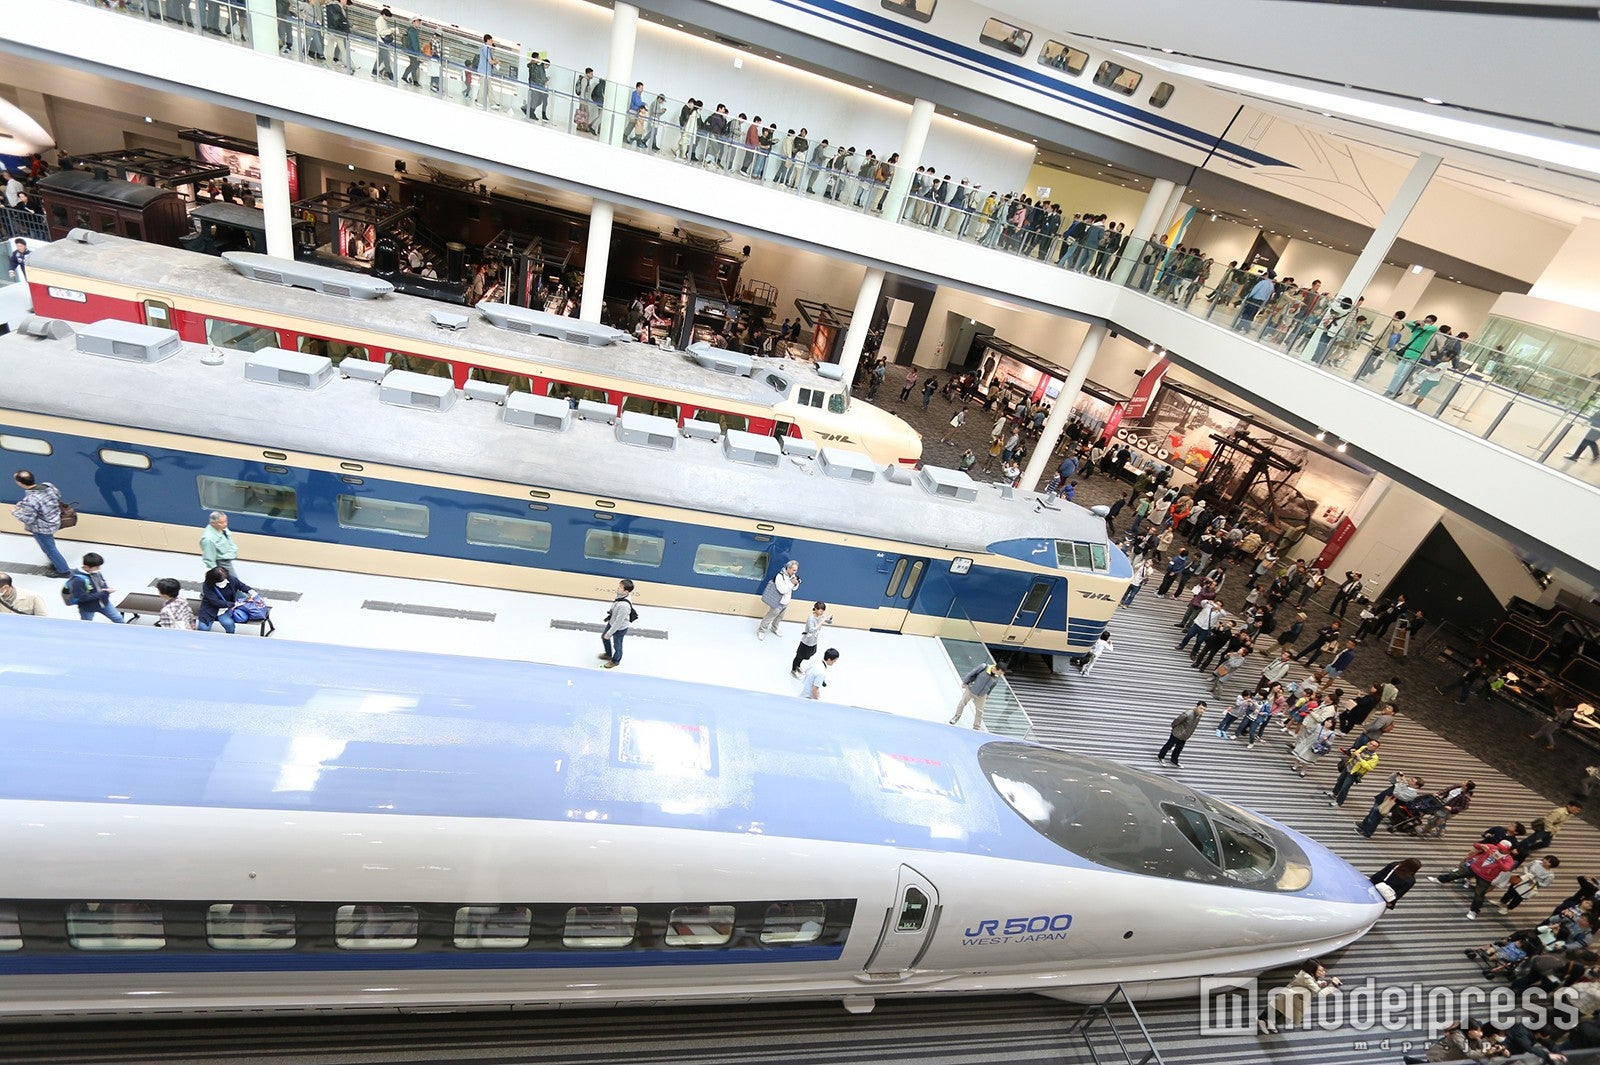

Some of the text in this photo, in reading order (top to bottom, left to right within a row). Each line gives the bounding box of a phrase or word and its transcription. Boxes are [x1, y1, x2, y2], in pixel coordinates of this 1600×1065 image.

[554, 759, 563, 772] 1
[964, 914, 1073, 937] JR 500
[962, 932, 1067, 946] WEST JAPAN
